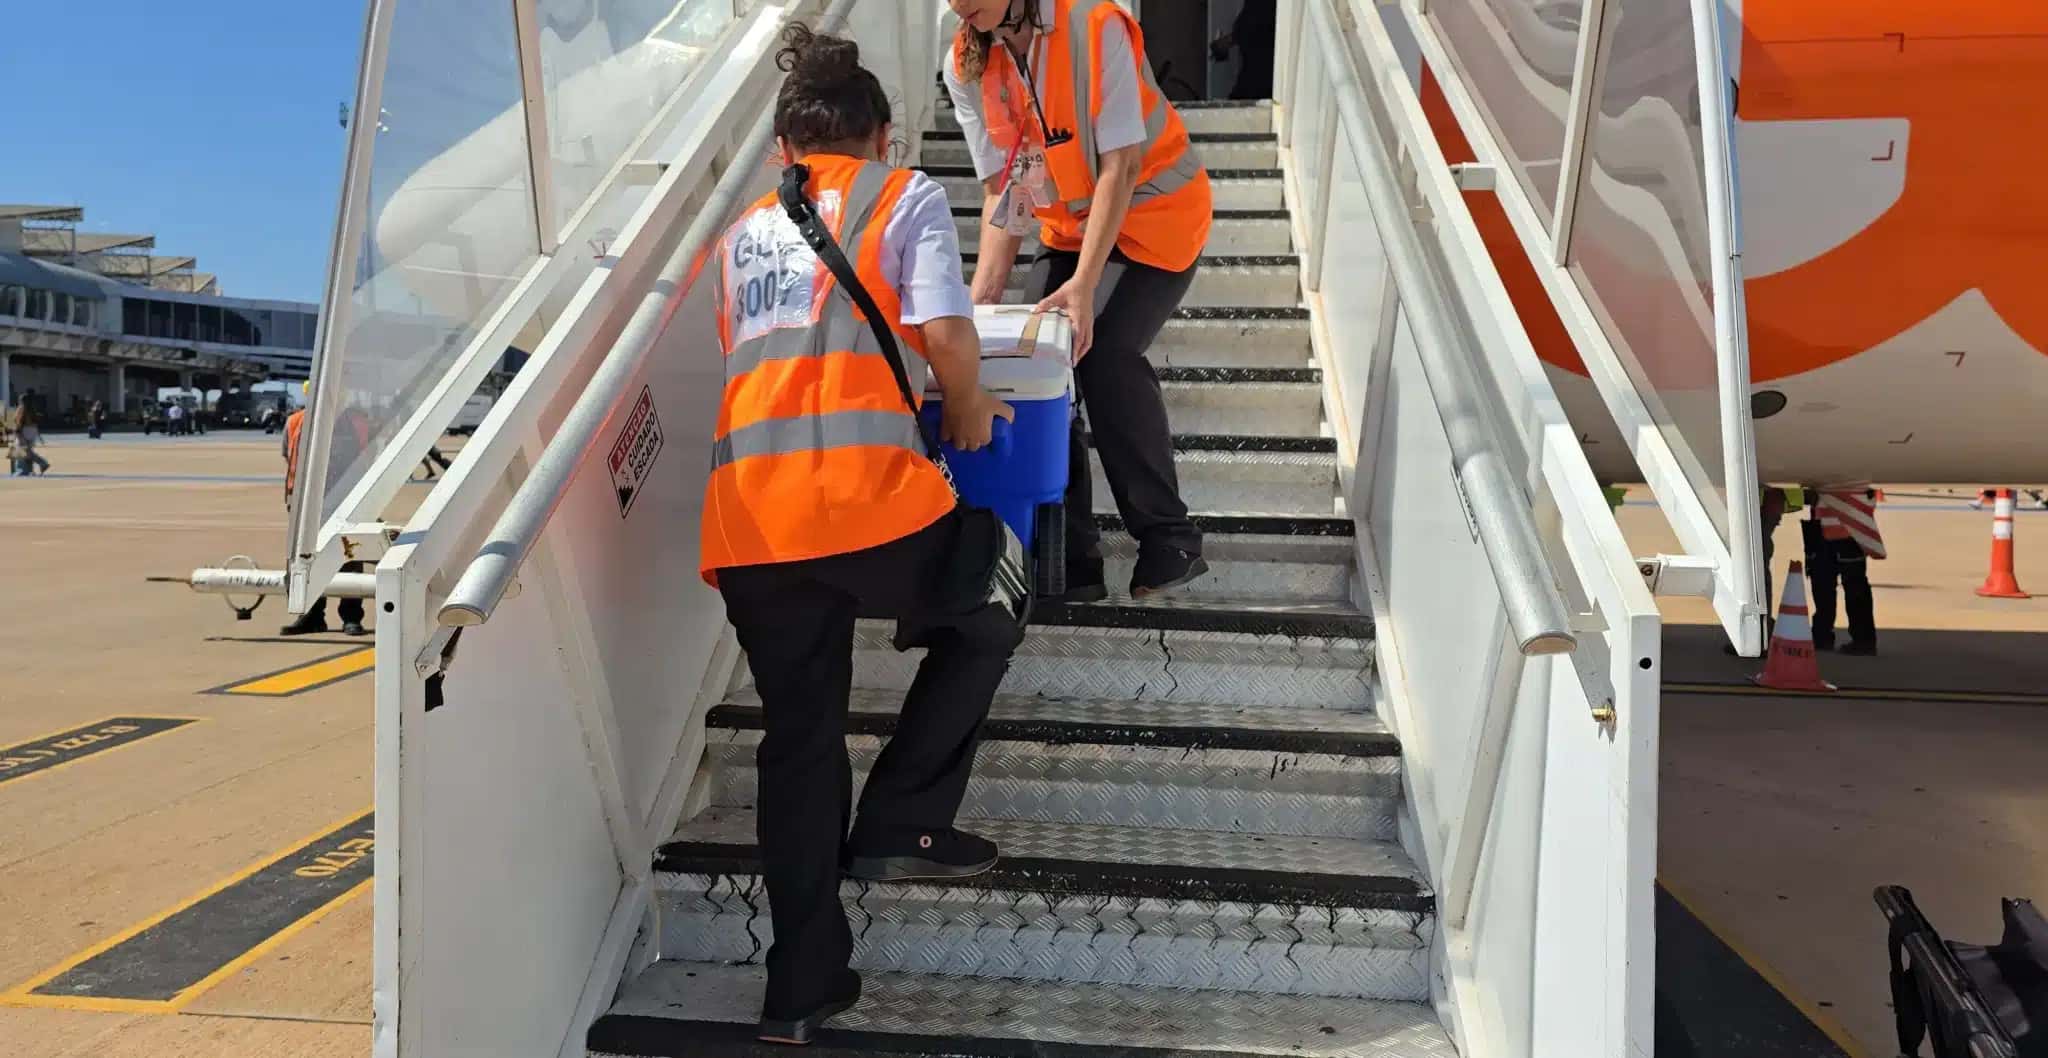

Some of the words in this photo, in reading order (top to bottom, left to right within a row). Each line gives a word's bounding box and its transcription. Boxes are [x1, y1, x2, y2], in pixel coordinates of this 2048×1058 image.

[736, 268, 802, 323] 3007
[628, 411, 656, 467] CUIDADO
[633, 430, 660, 483] ESCADA
